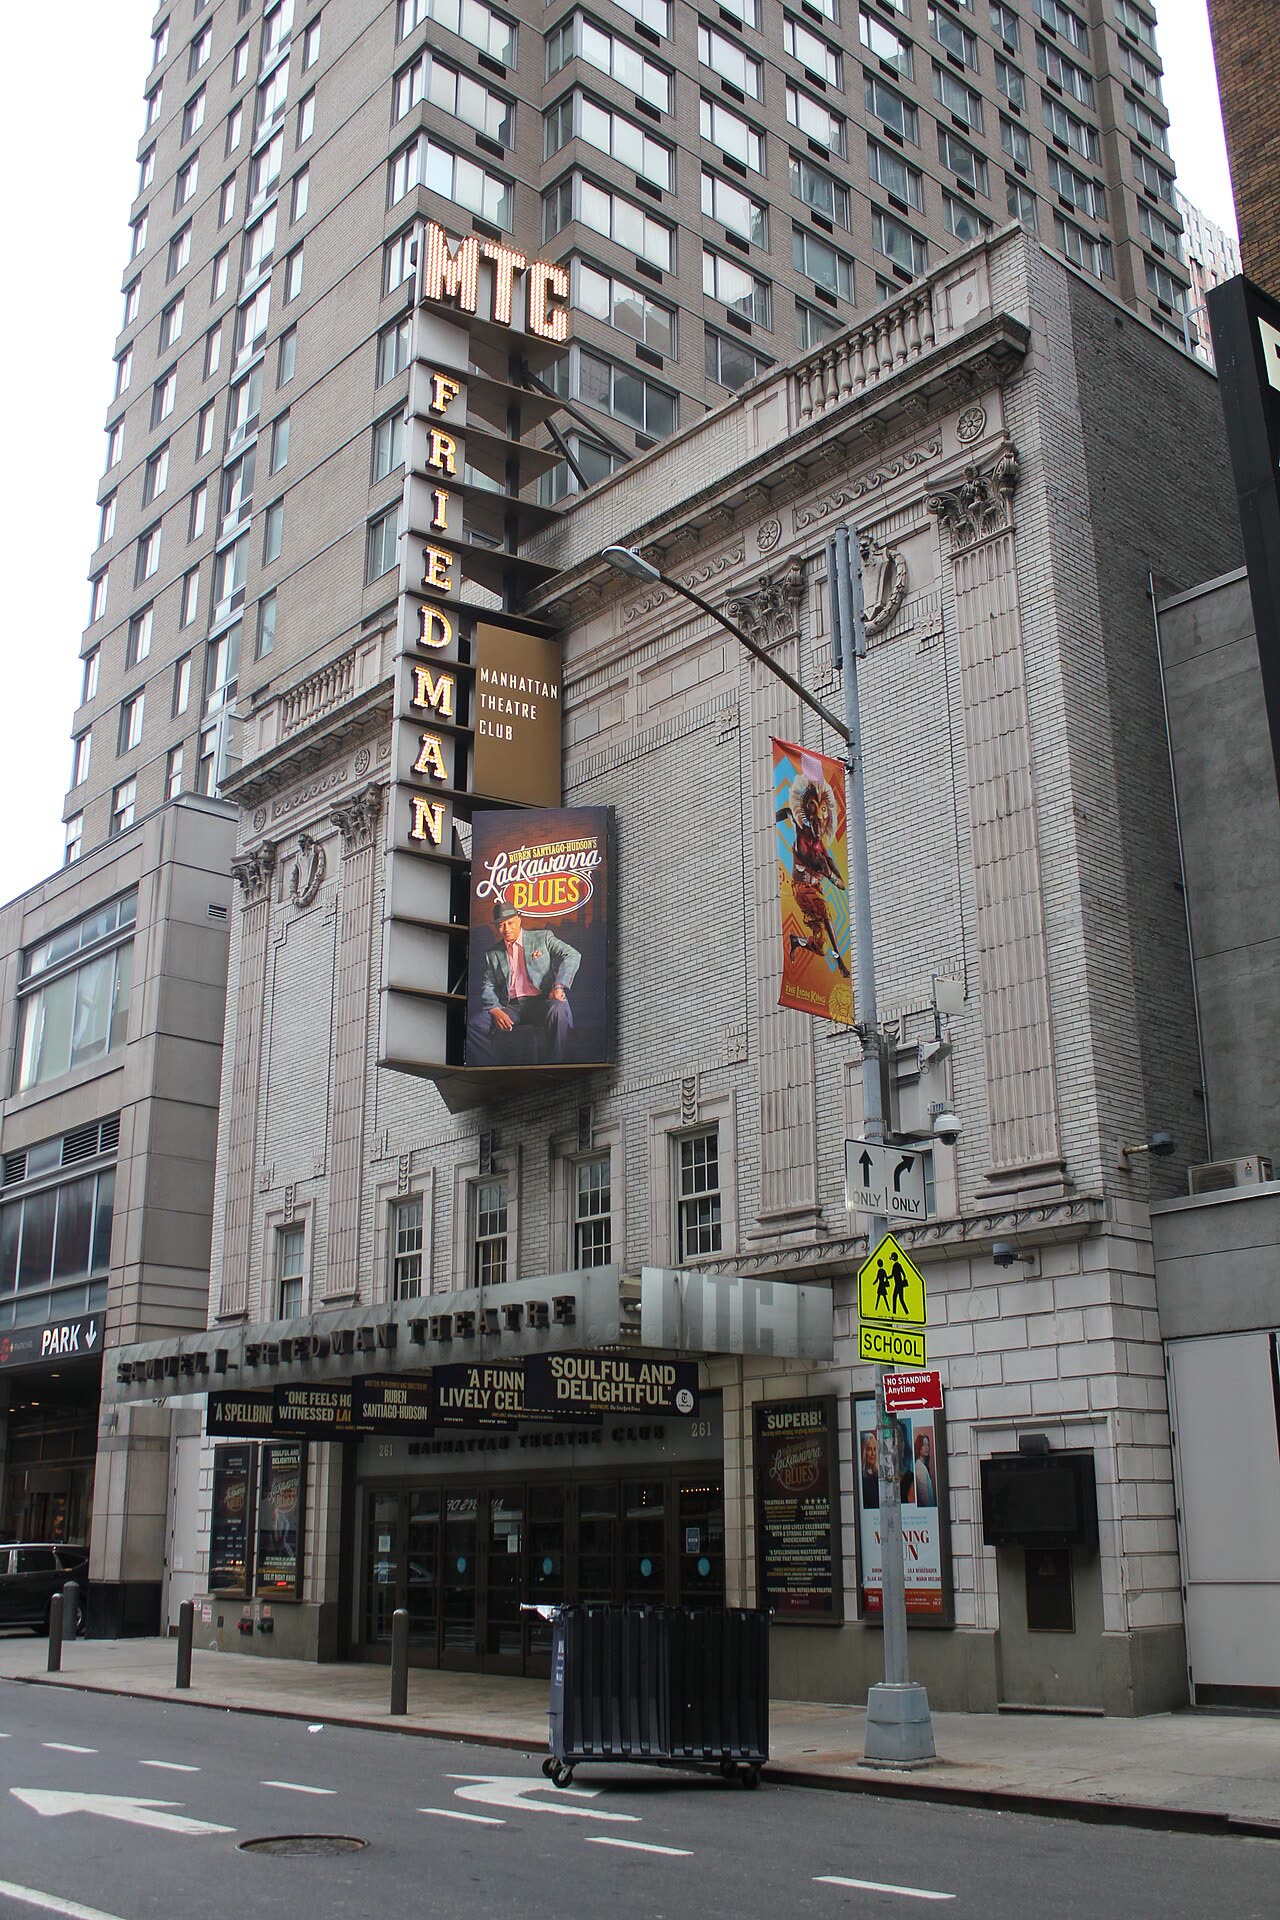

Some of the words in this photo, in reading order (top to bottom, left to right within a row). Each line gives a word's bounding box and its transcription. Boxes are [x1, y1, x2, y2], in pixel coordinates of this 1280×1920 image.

[424, 221, 569, 342] MTC
[408, 373, 460, 845] FRIEDMAN
[480, 667, 559, 699] MANHATTAN
[480, 693, 537, 720] THEATRE
[479, 719, 513, 741] CLUB
[509, 850, 532, 864] RUBEN
[533, 839, 598, 858] SANTIAGO-HUDSON'S
[476, 847, 602, 901] Lackawanna
[513, 876, 581, 909] BLUES
[785, 985, 797, 995] THE
[796, 986, 811, 998] LION
[811, 990, 826, 1004] KING
[852, 1191, 881, 1207] ONLY
[892, 1197, 920, 1213] ONLY
[41, 1323, 81, 1356] PARK
[117, 1351, 210, 1384] SAMUEL
[244, 1323, 398, 1367] FRIEDMAN
[407, 1295, 576, 1345] THEATRE
[864, 1333, 922, 1357] SCHOOL
[548, 1356, 635, 1383] “SOULFUL
[639, 1364, 676, 1386] AND
[887, 1377, 897, 1386] NO
[898, 1375, 931, 1385] STANDING
[309, 1392, 338, 1407] FEELS
[384, 1389, 407, 1404] RUBEN
[440, 1387, 491, 1409] LIVELY
[888, 1386, 916, 1398] Anytime
[279, 1405, 334, 1422] WITNESSED
[362, 1403, 428, 1421] SANTIAGO-HUDSON
[691, 1422, 712, 1438] 261
[379, 1444, 392, 1457] 261
[785, 1465, 814, 1485] BLUES
